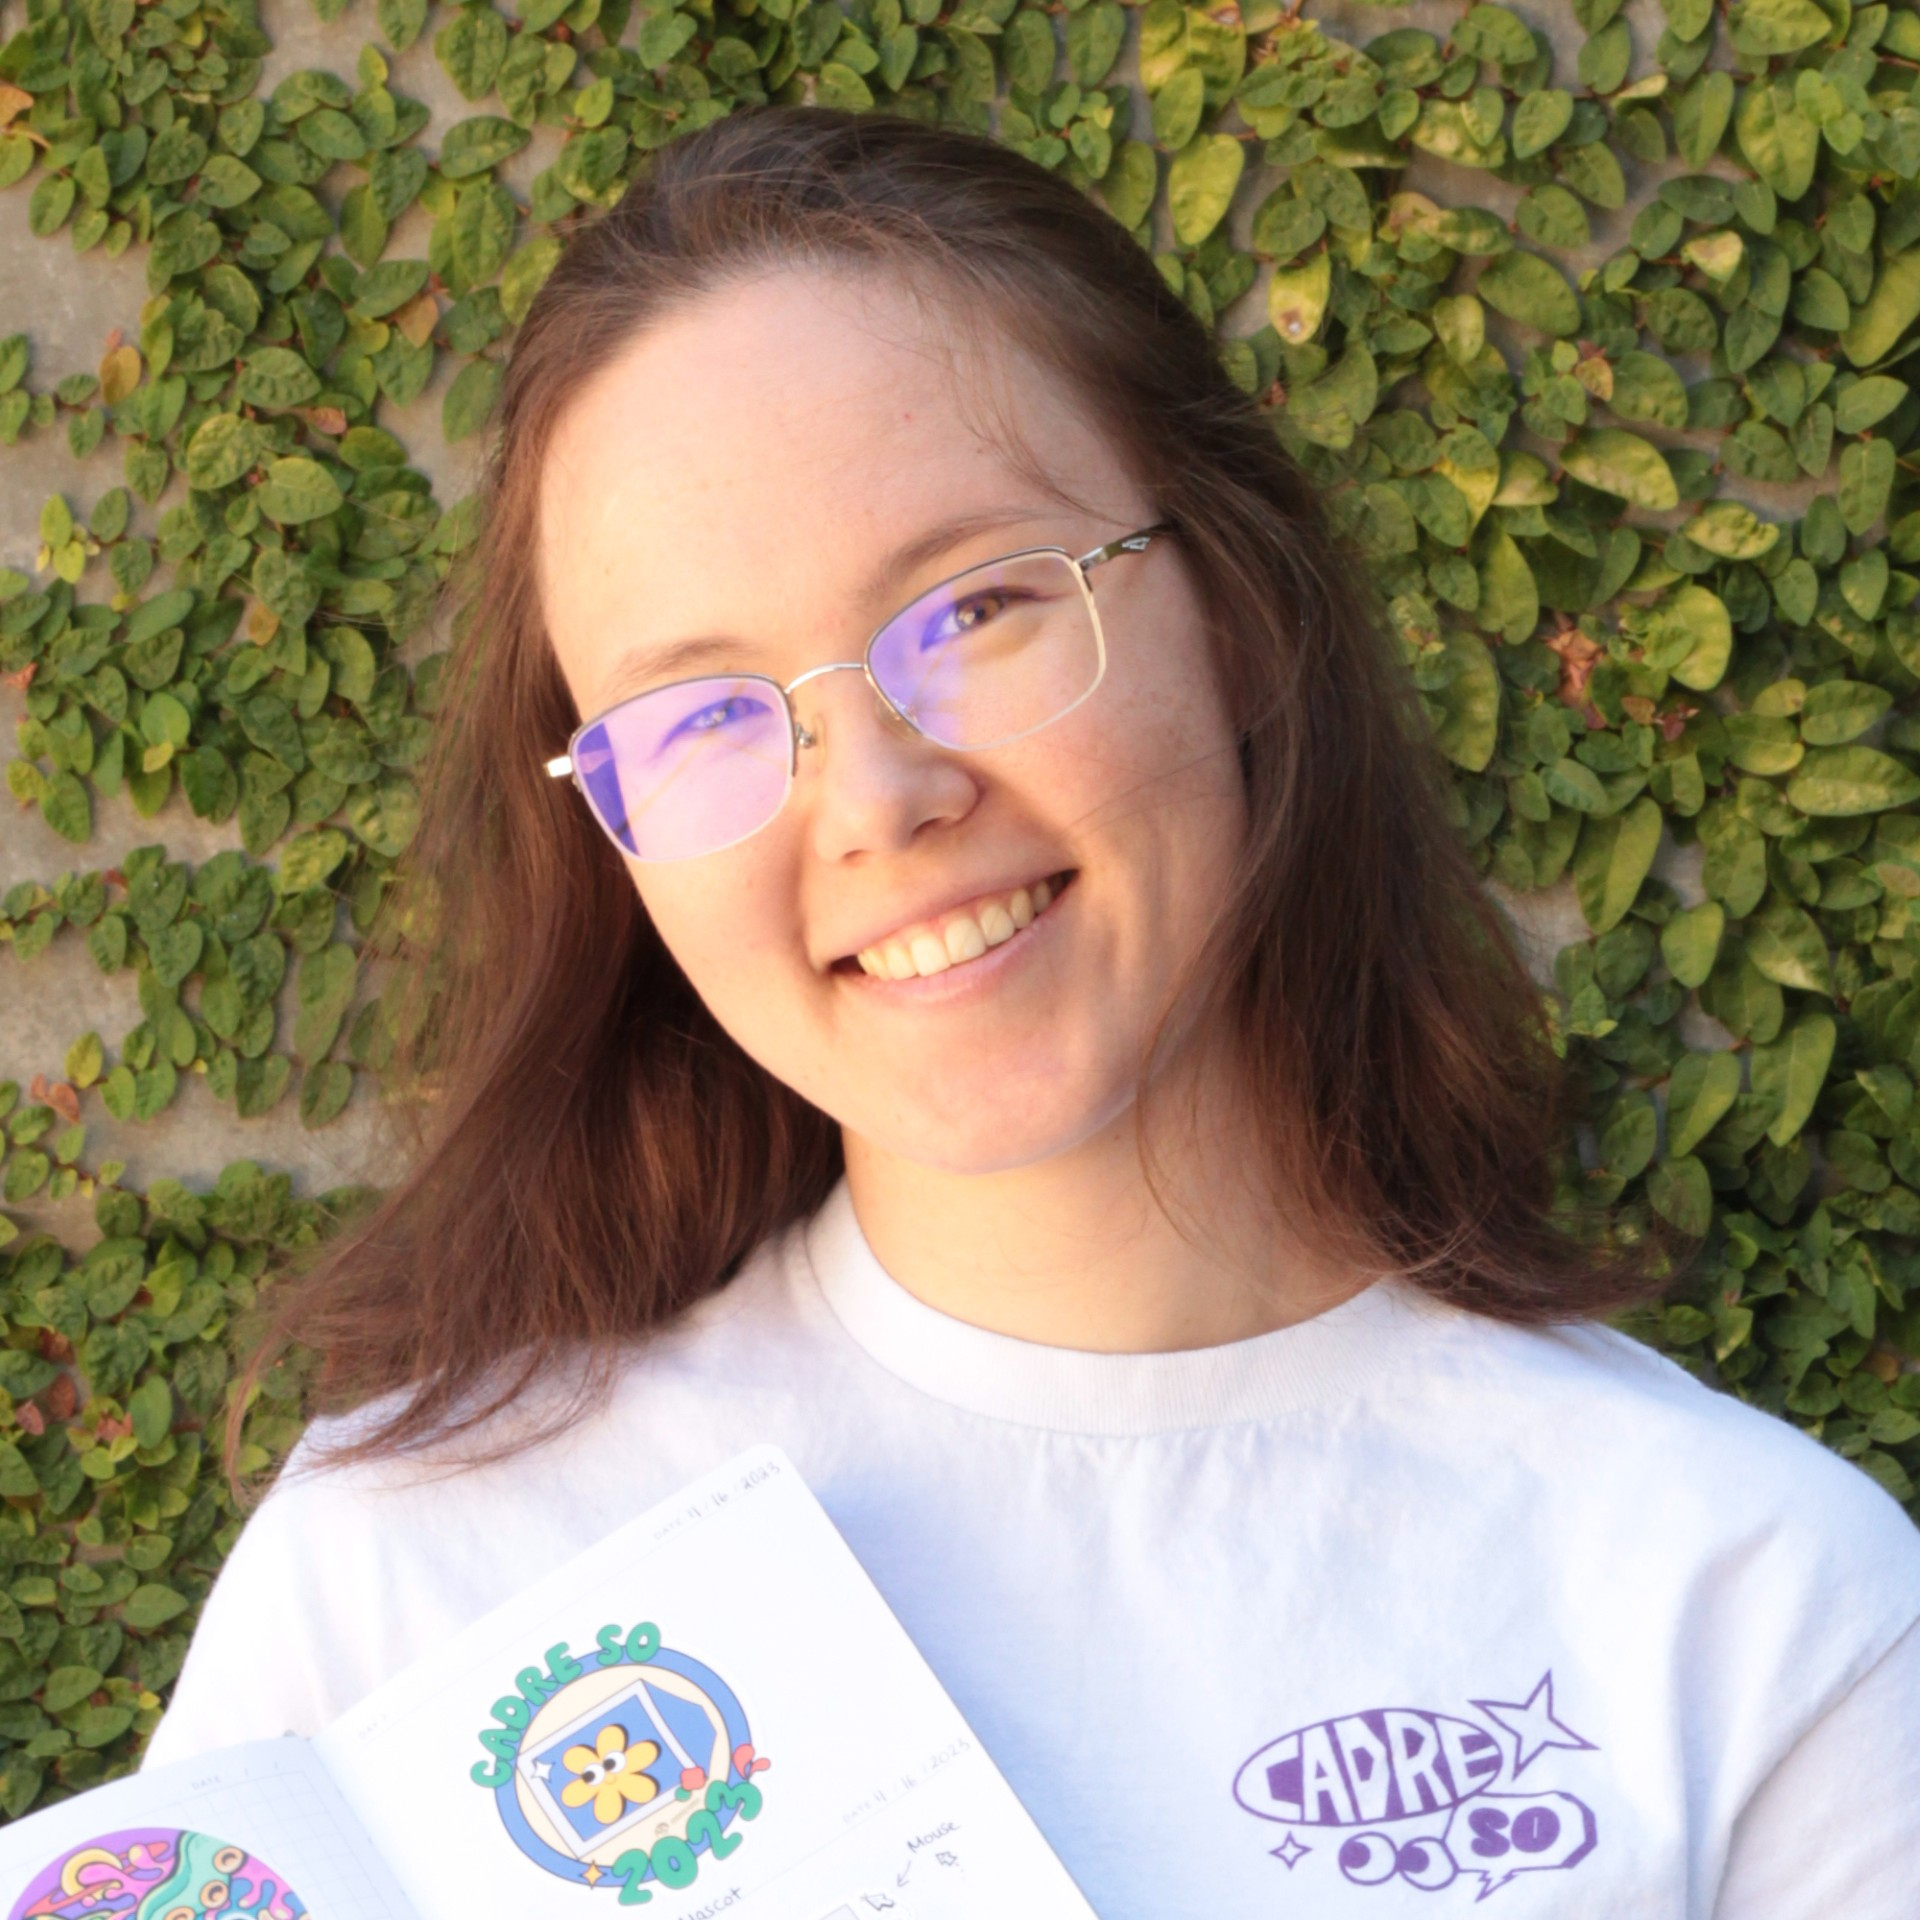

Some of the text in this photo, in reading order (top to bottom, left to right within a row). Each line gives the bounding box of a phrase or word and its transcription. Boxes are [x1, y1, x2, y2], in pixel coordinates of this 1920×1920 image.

[471, 1622, 661, 1788] CADRE SO
[1235, 1709, 1503, 1826] CADRE
[611, 1780, 763, 1906] 2023
[906, 1821, 961, 1852] Mouse
[1468, 1806, 1560, 1858] SO
